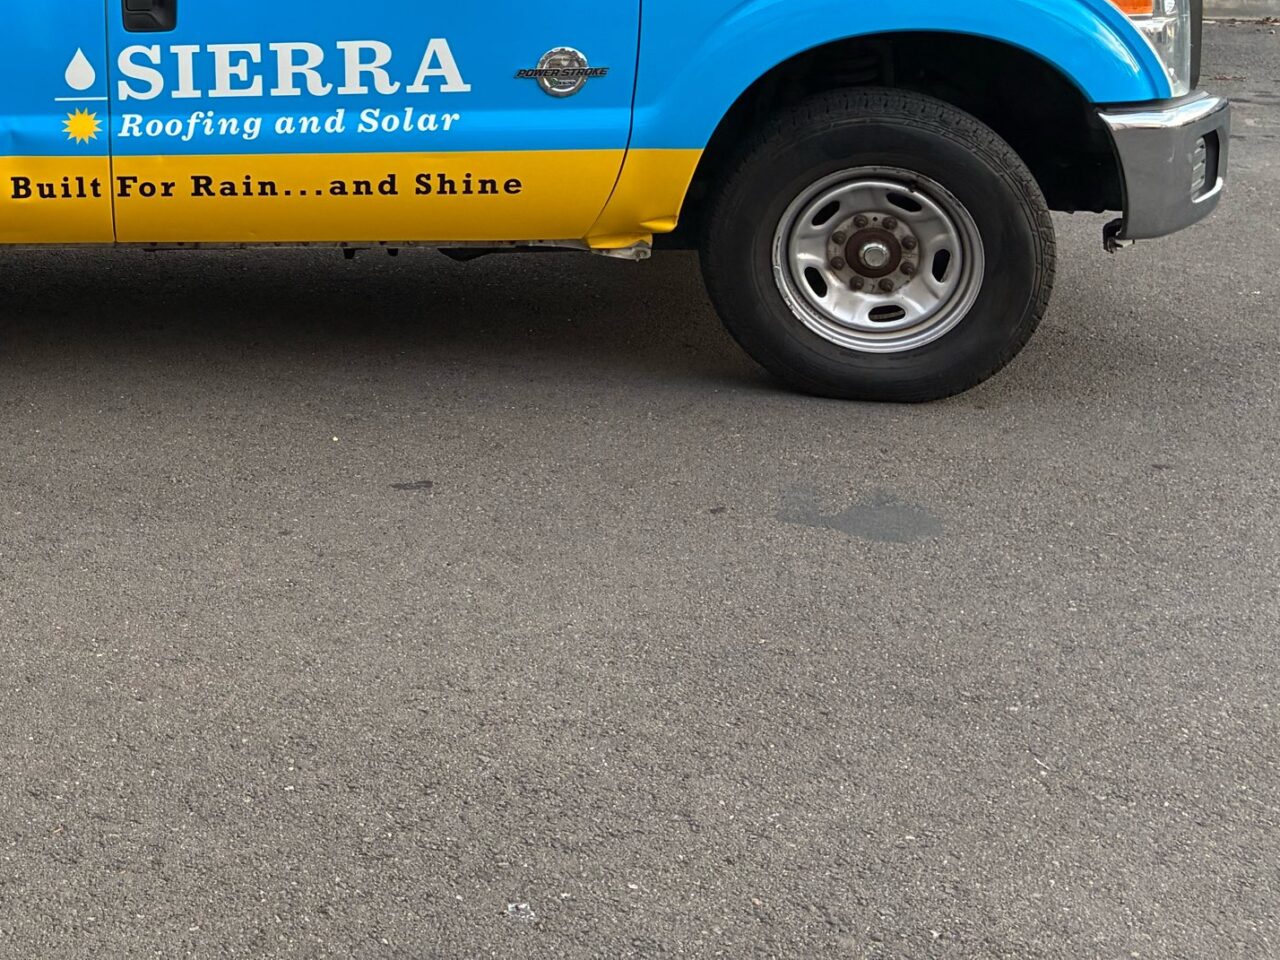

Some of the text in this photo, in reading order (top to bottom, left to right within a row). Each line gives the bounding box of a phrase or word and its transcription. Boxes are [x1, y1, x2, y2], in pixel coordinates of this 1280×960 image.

[117, 38, 472, 101] SIERRA
[516, 67, 609, 77] POWER STROKE
[118, 106, 460, 140] Roofing and Solar
[11, 176, 101, 199] Built
[117, 175, 176, 198] For
[415, 172, 523, 196] Shine
